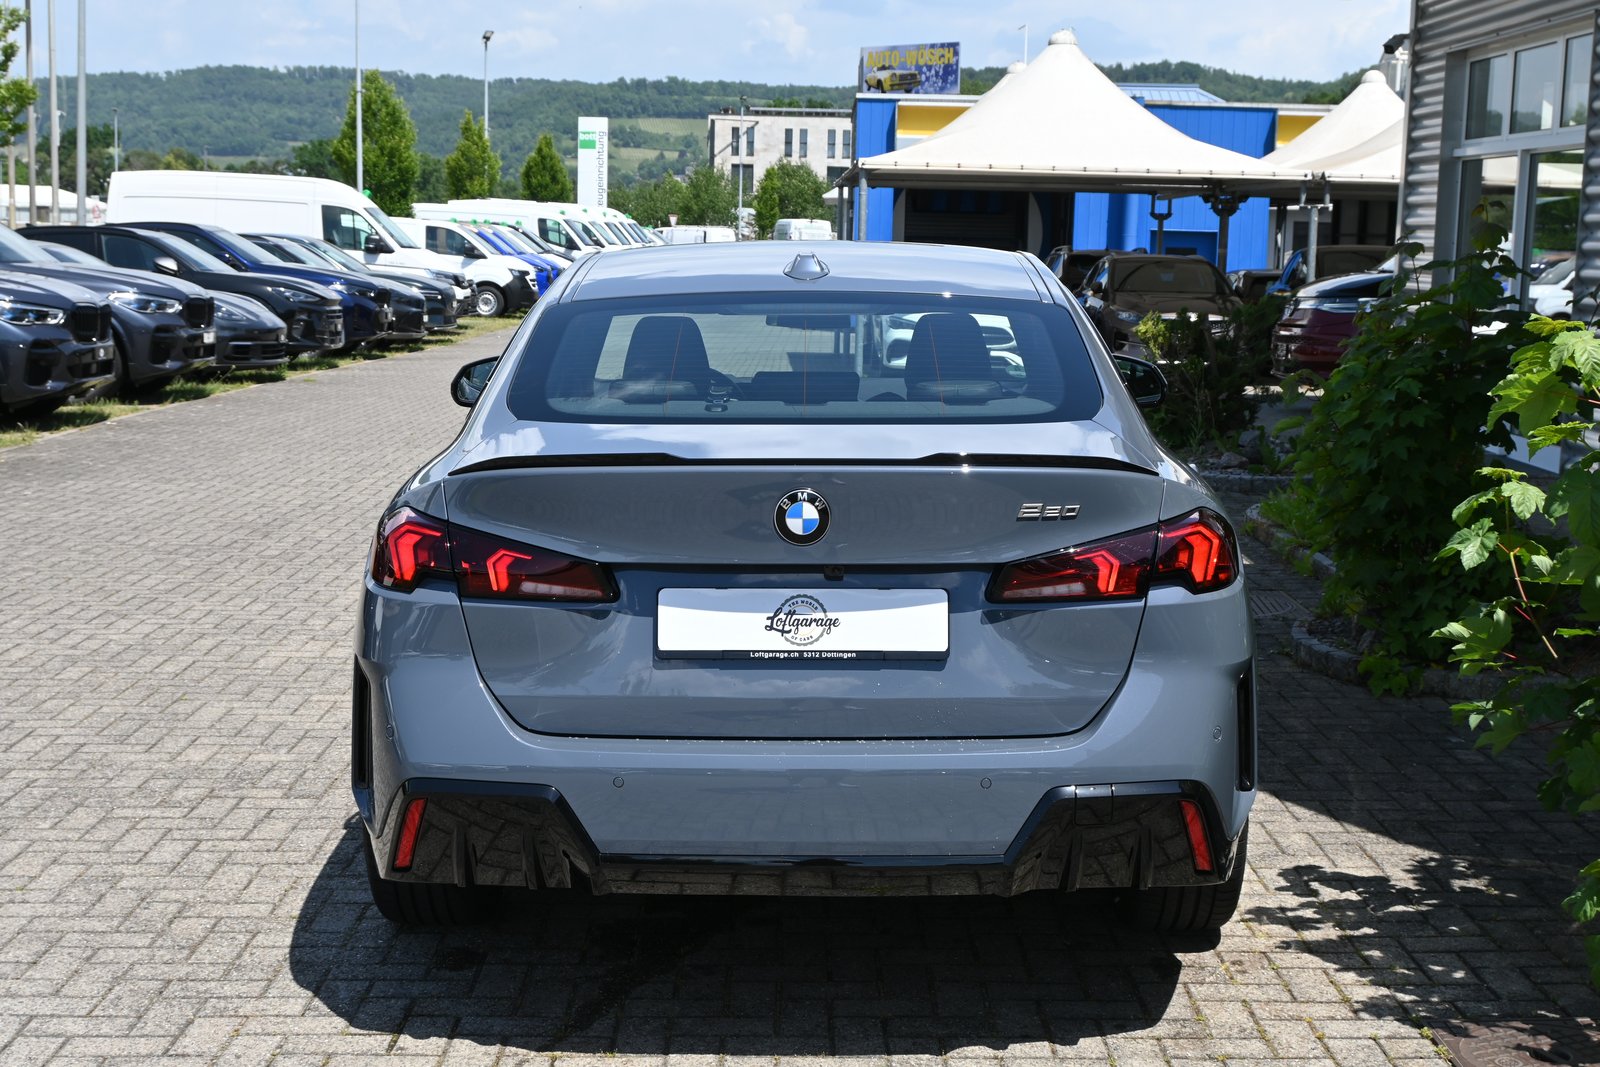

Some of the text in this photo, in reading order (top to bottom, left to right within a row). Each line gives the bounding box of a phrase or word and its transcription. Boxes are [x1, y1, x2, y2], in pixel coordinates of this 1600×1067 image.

[865, 44, 955, 68] AUTO-WÖSCH
[596, 131, 607, 207] eugeinrichtung
[780, 492, 826, 510] BMW
[1017, 503, 1081, 518] 220
[788, 600, 818, 611] THE WORLD
[764, 606, 840, 637] Loftgarage
[750, 651, 799, 659] Loftgarage.ch
